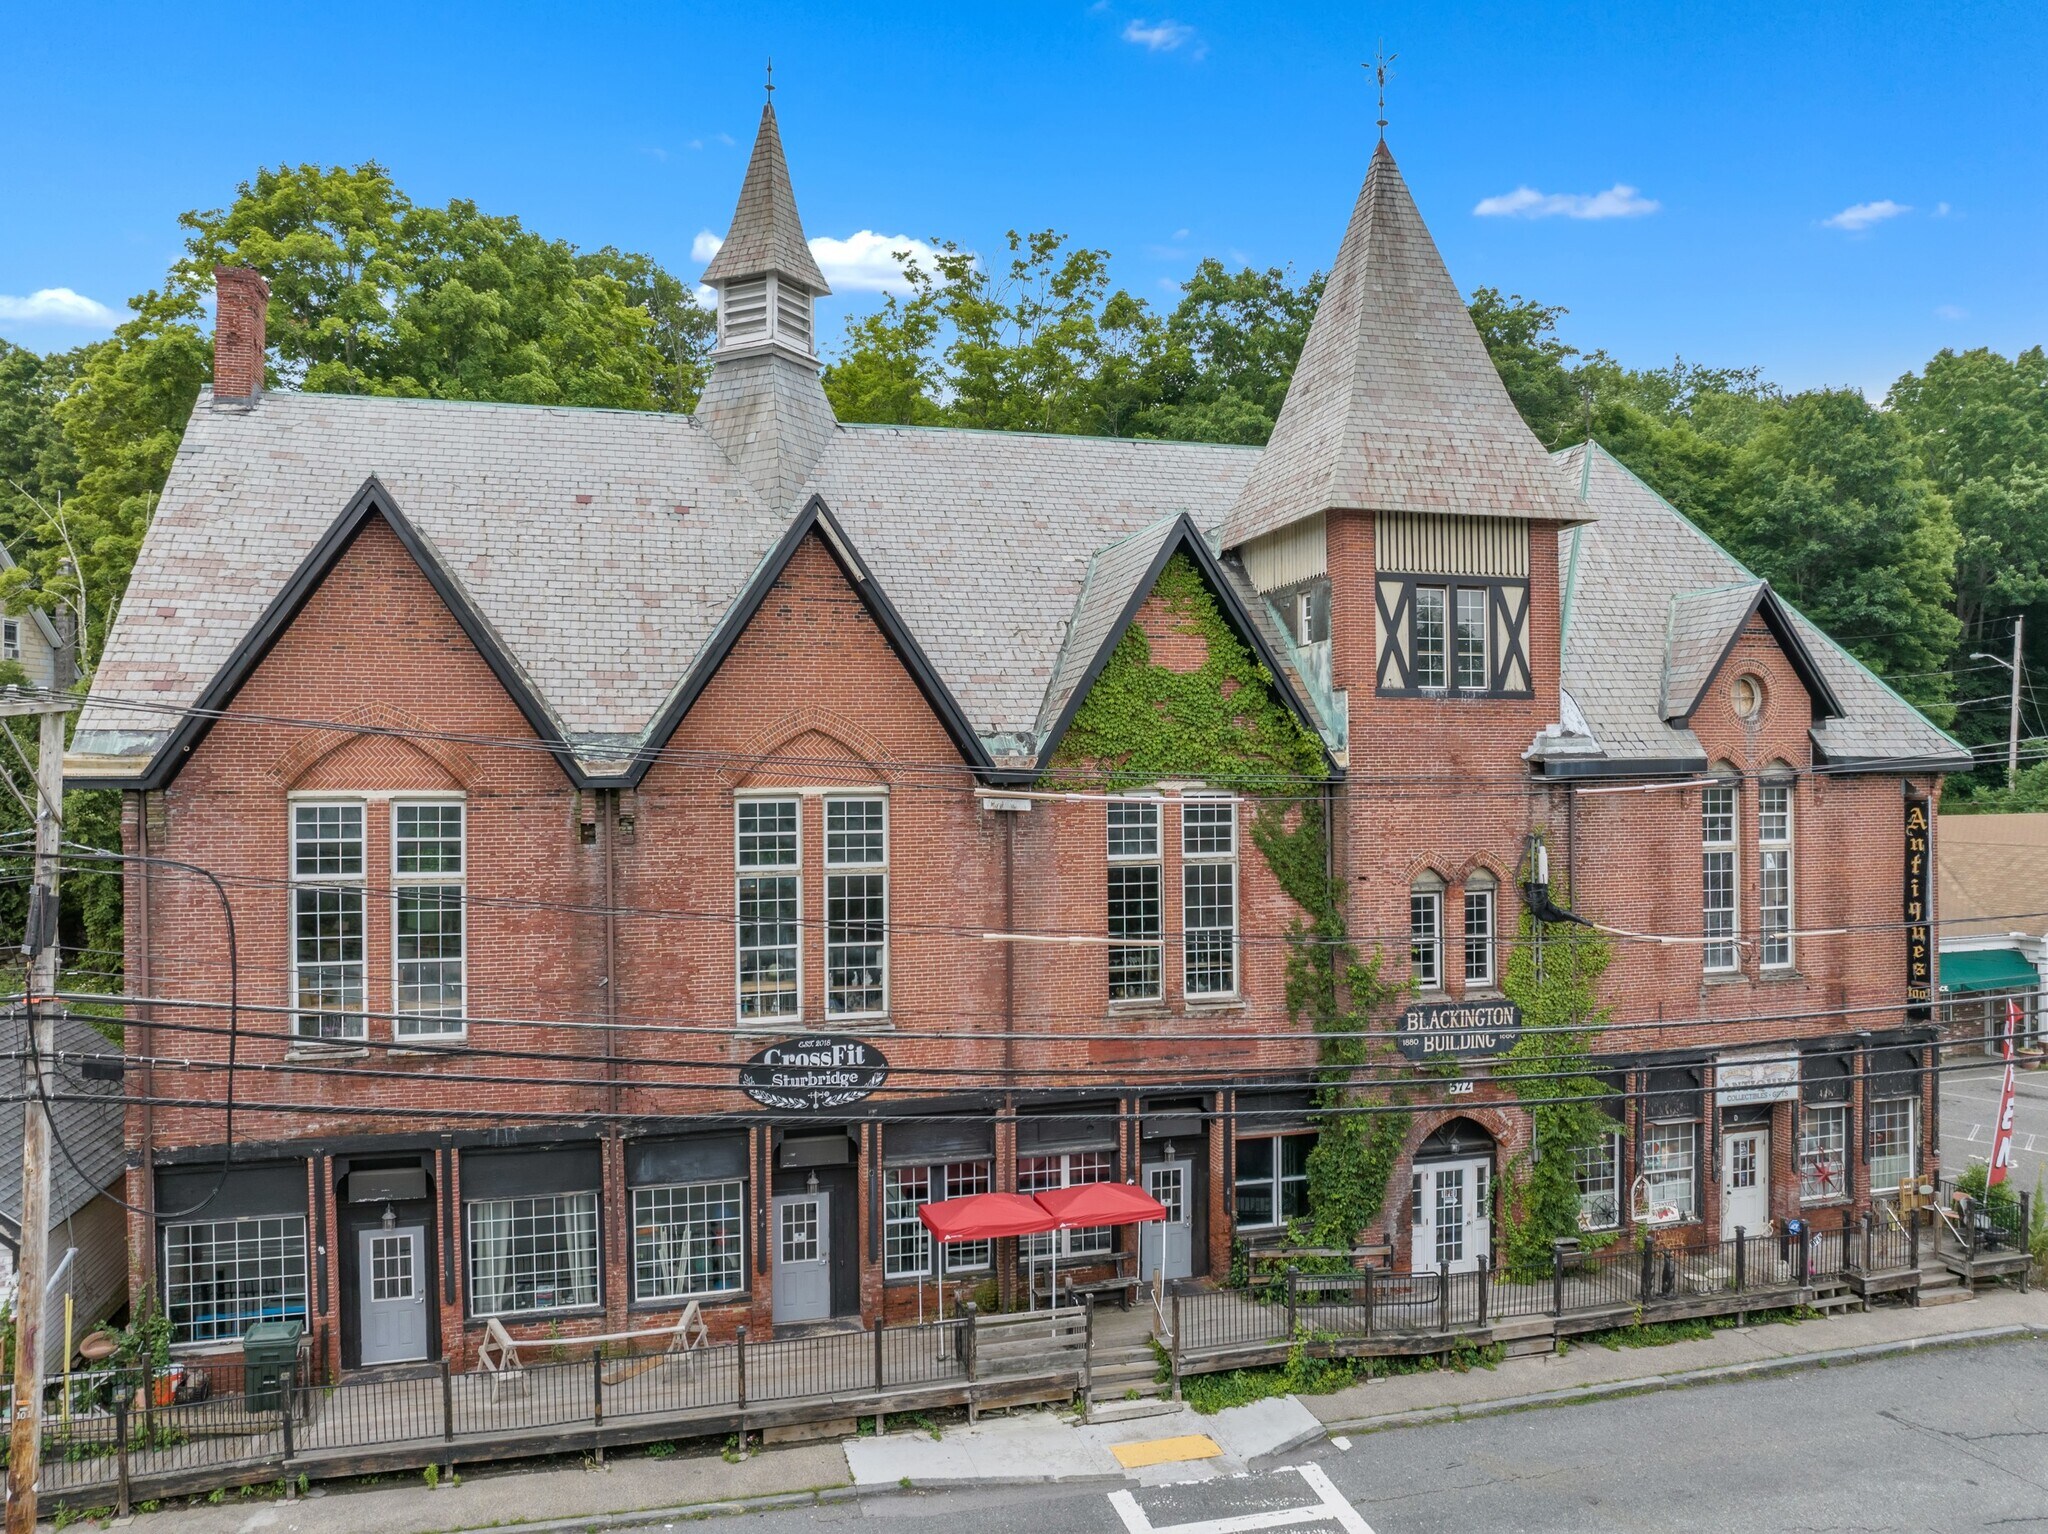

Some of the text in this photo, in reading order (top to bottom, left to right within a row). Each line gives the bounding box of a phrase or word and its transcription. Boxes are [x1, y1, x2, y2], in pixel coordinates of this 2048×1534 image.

[1906, 807, 1928, 976] Antiques
[1406, 1007, 1515, 1031] BLACKINGTON
[1402, 1038, 1419, 1046] 1880
[1423, 1034, 1496, 1052] BUILDING
[764, 1044, 866, 1071] CrossFit
[772, 1071, 859, 1088] Sturbridge
